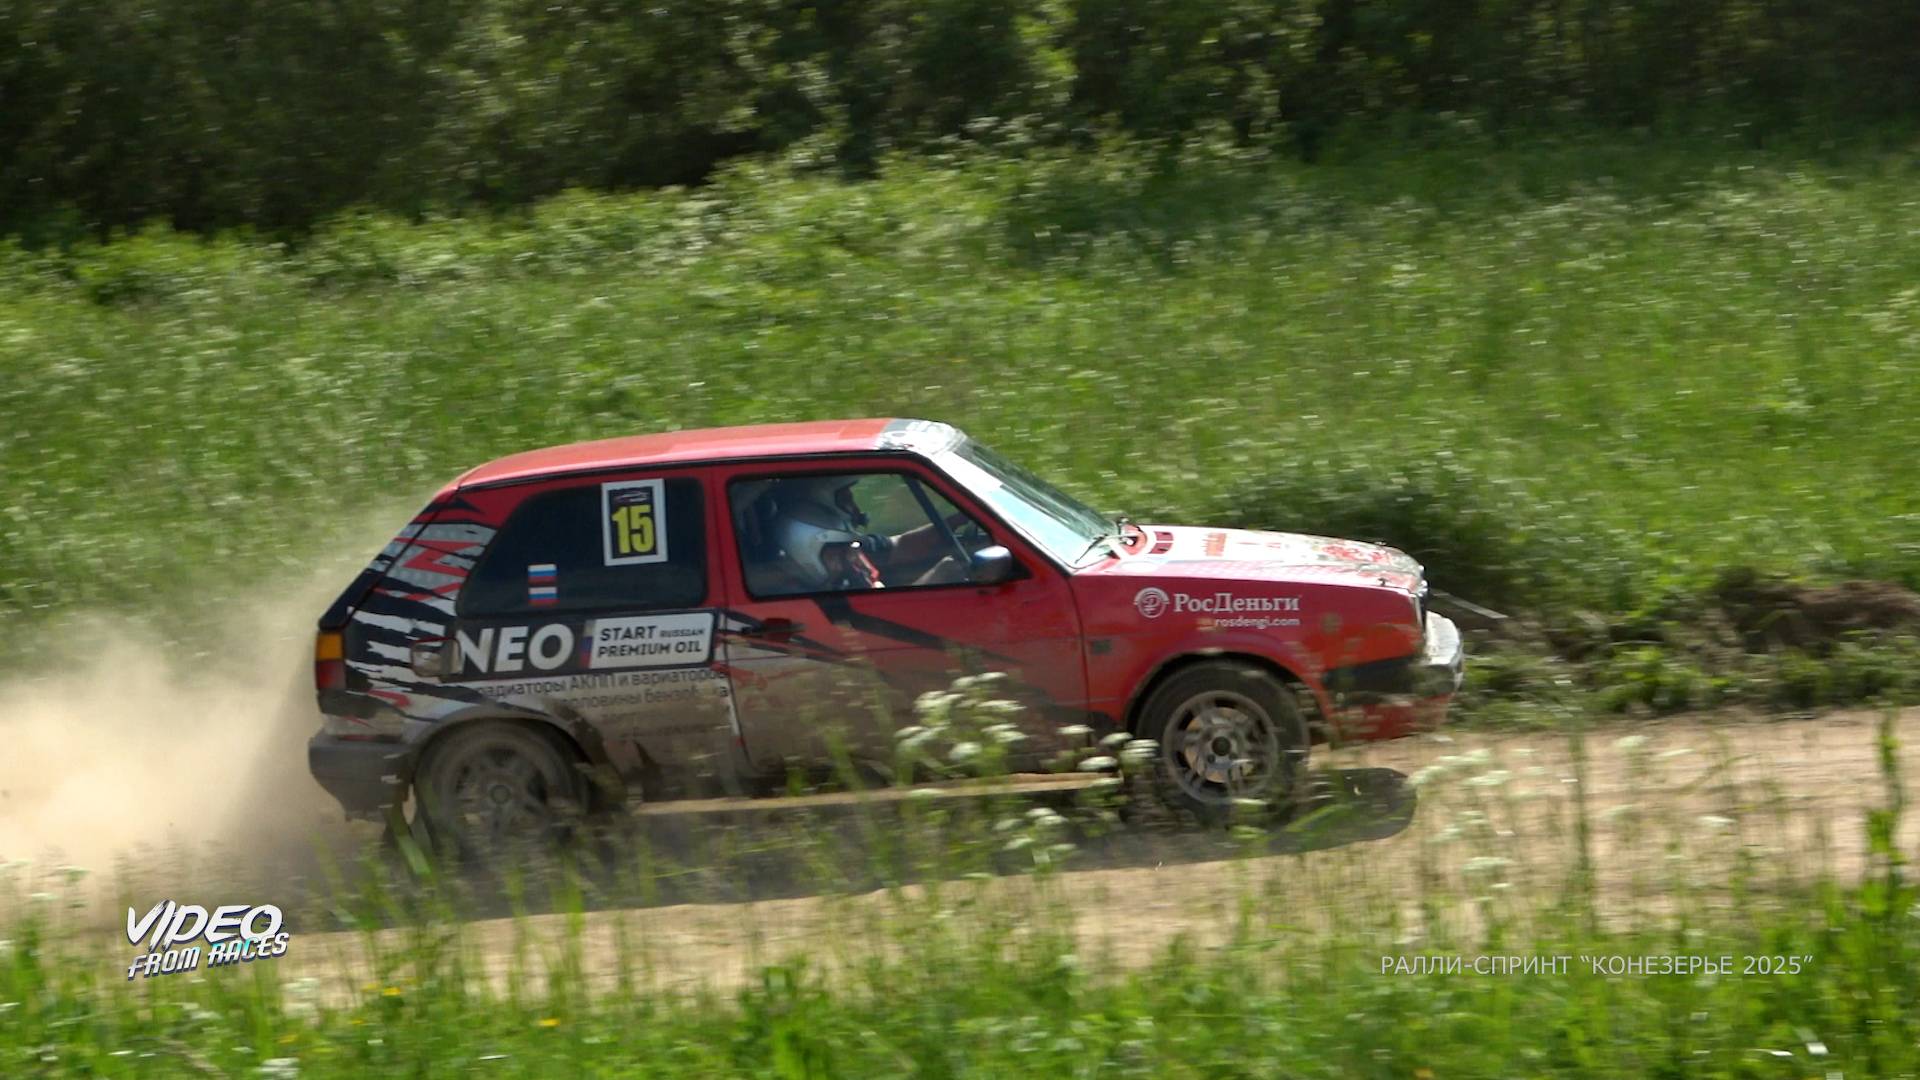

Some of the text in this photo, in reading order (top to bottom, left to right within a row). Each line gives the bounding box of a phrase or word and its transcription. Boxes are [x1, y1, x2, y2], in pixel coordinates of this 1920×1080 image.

[611, 504, 655, 554] 15
[1173, 592, 1299, 613] РосДеньги
[1215, 616, 1300, 629] rosdengi.com
[600, 625, 657, 641] START
[457, 623, 574, 674] NEO
[597, 640, 702, 658] PREMIUM OIL
[570, 673, 616, 690] АКПП
[618, 675, 629, 687] и
